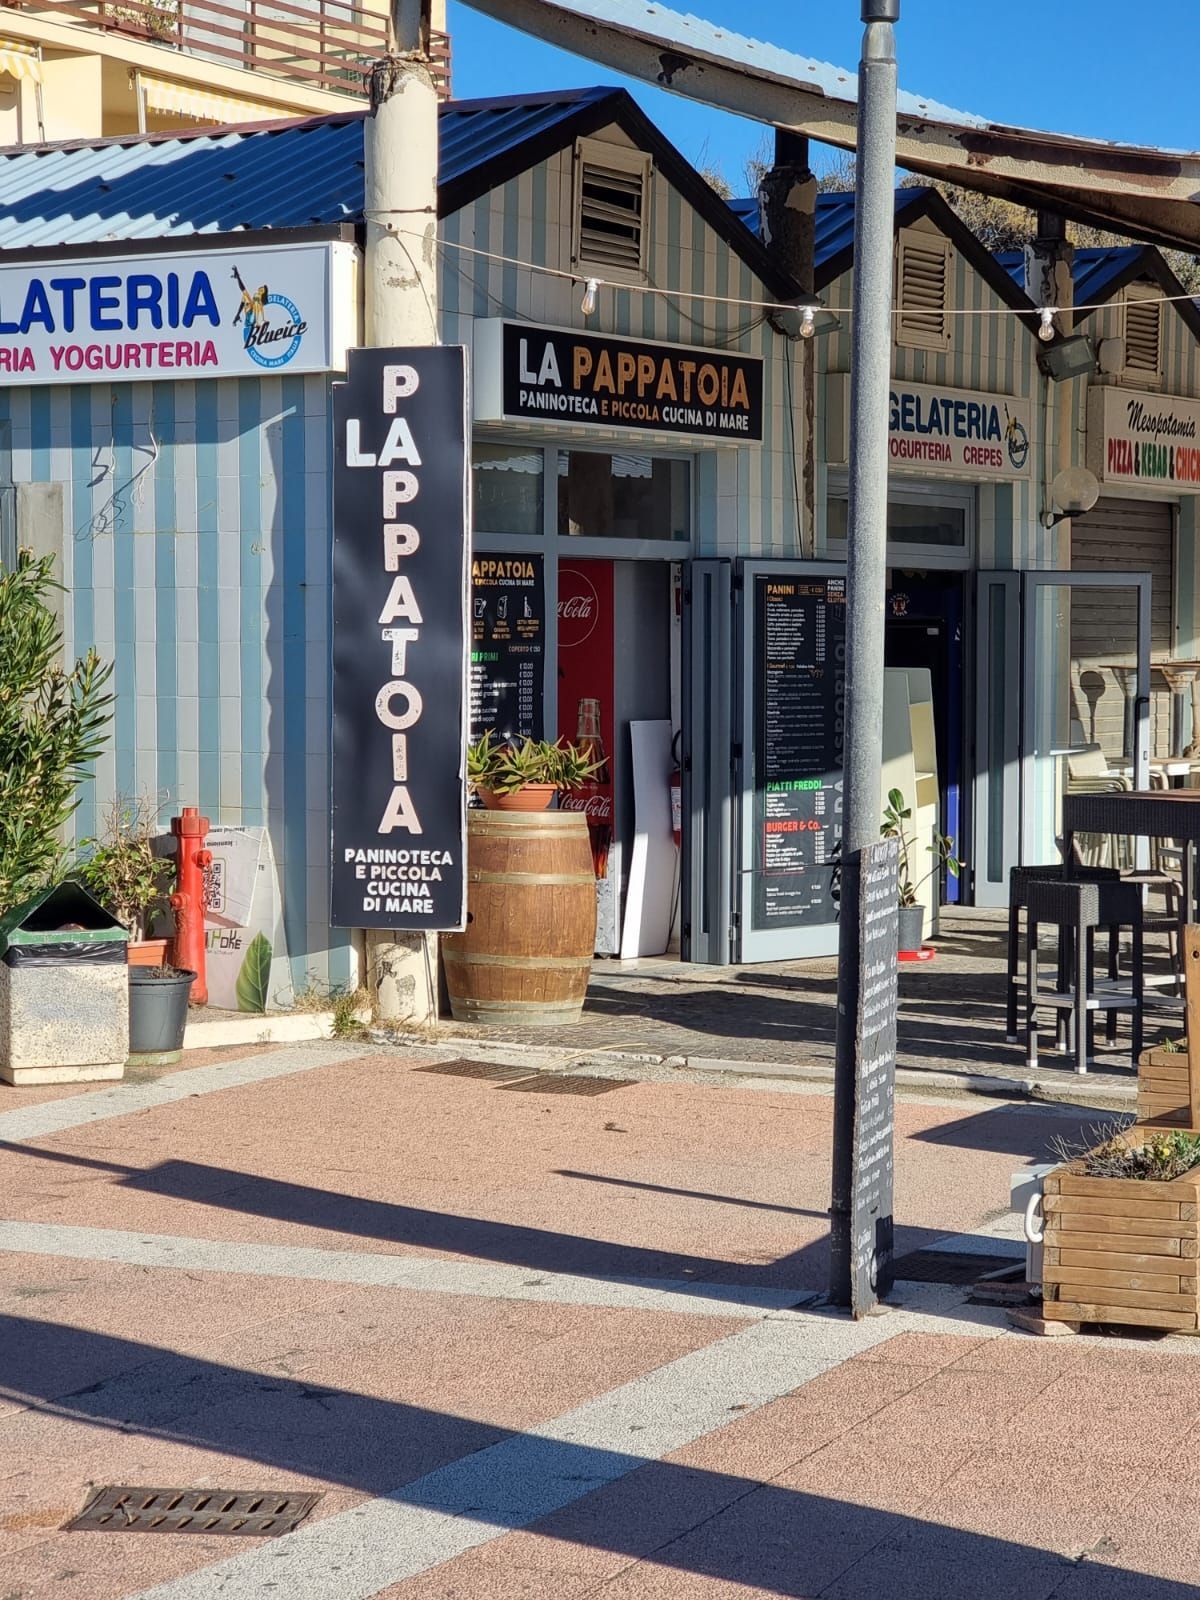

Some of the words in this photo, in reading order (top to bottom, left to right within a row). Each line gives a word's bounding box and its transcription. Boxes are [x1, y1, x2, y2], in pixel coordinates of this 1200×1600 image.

[243, 319, 309, 350] Blueice
[49, 340, 219, 371] YOGURTERIA
[519, 338, 562, 388] LA
[572, 346, 750, 410] PAPPATOIA
[519, 390, 598, 415] PANINOTECA
[601, 401, 609, 416] E
[611, 402, 660, 422] PICCOLA
[662, 406, 704, 426] CUCINA
[705, 412, 717, 428] DI
[719, 414, 749, 431] MARE
[1127, 400, 1196, 441] Mesopotamia
[888, 438, 952, 462] OGURTERIA
[963, 445, 1003, 467] CREPES
[1108, 438, 1133, 475] PIZZA
[1141, 442, 1168, 479] KEBAB
[472, 560, 535, 578] APPATOIA
[767, 584, 795, 595] PANINI
[767, 781, 792, 792] PIATTI
[794, 780, 822, 791] FREDDI
[766, 821, 798, 833] BURGER
[344, 848, 453, 865] PANINOTECA
[355, 865, 366, 879] E
[370, 865, 442, 881] PICCOLA
[366, 881, 431, 897] CUCINA
[362, 897, 380, 911] DI
[385, 898, 434, 914] MARE
